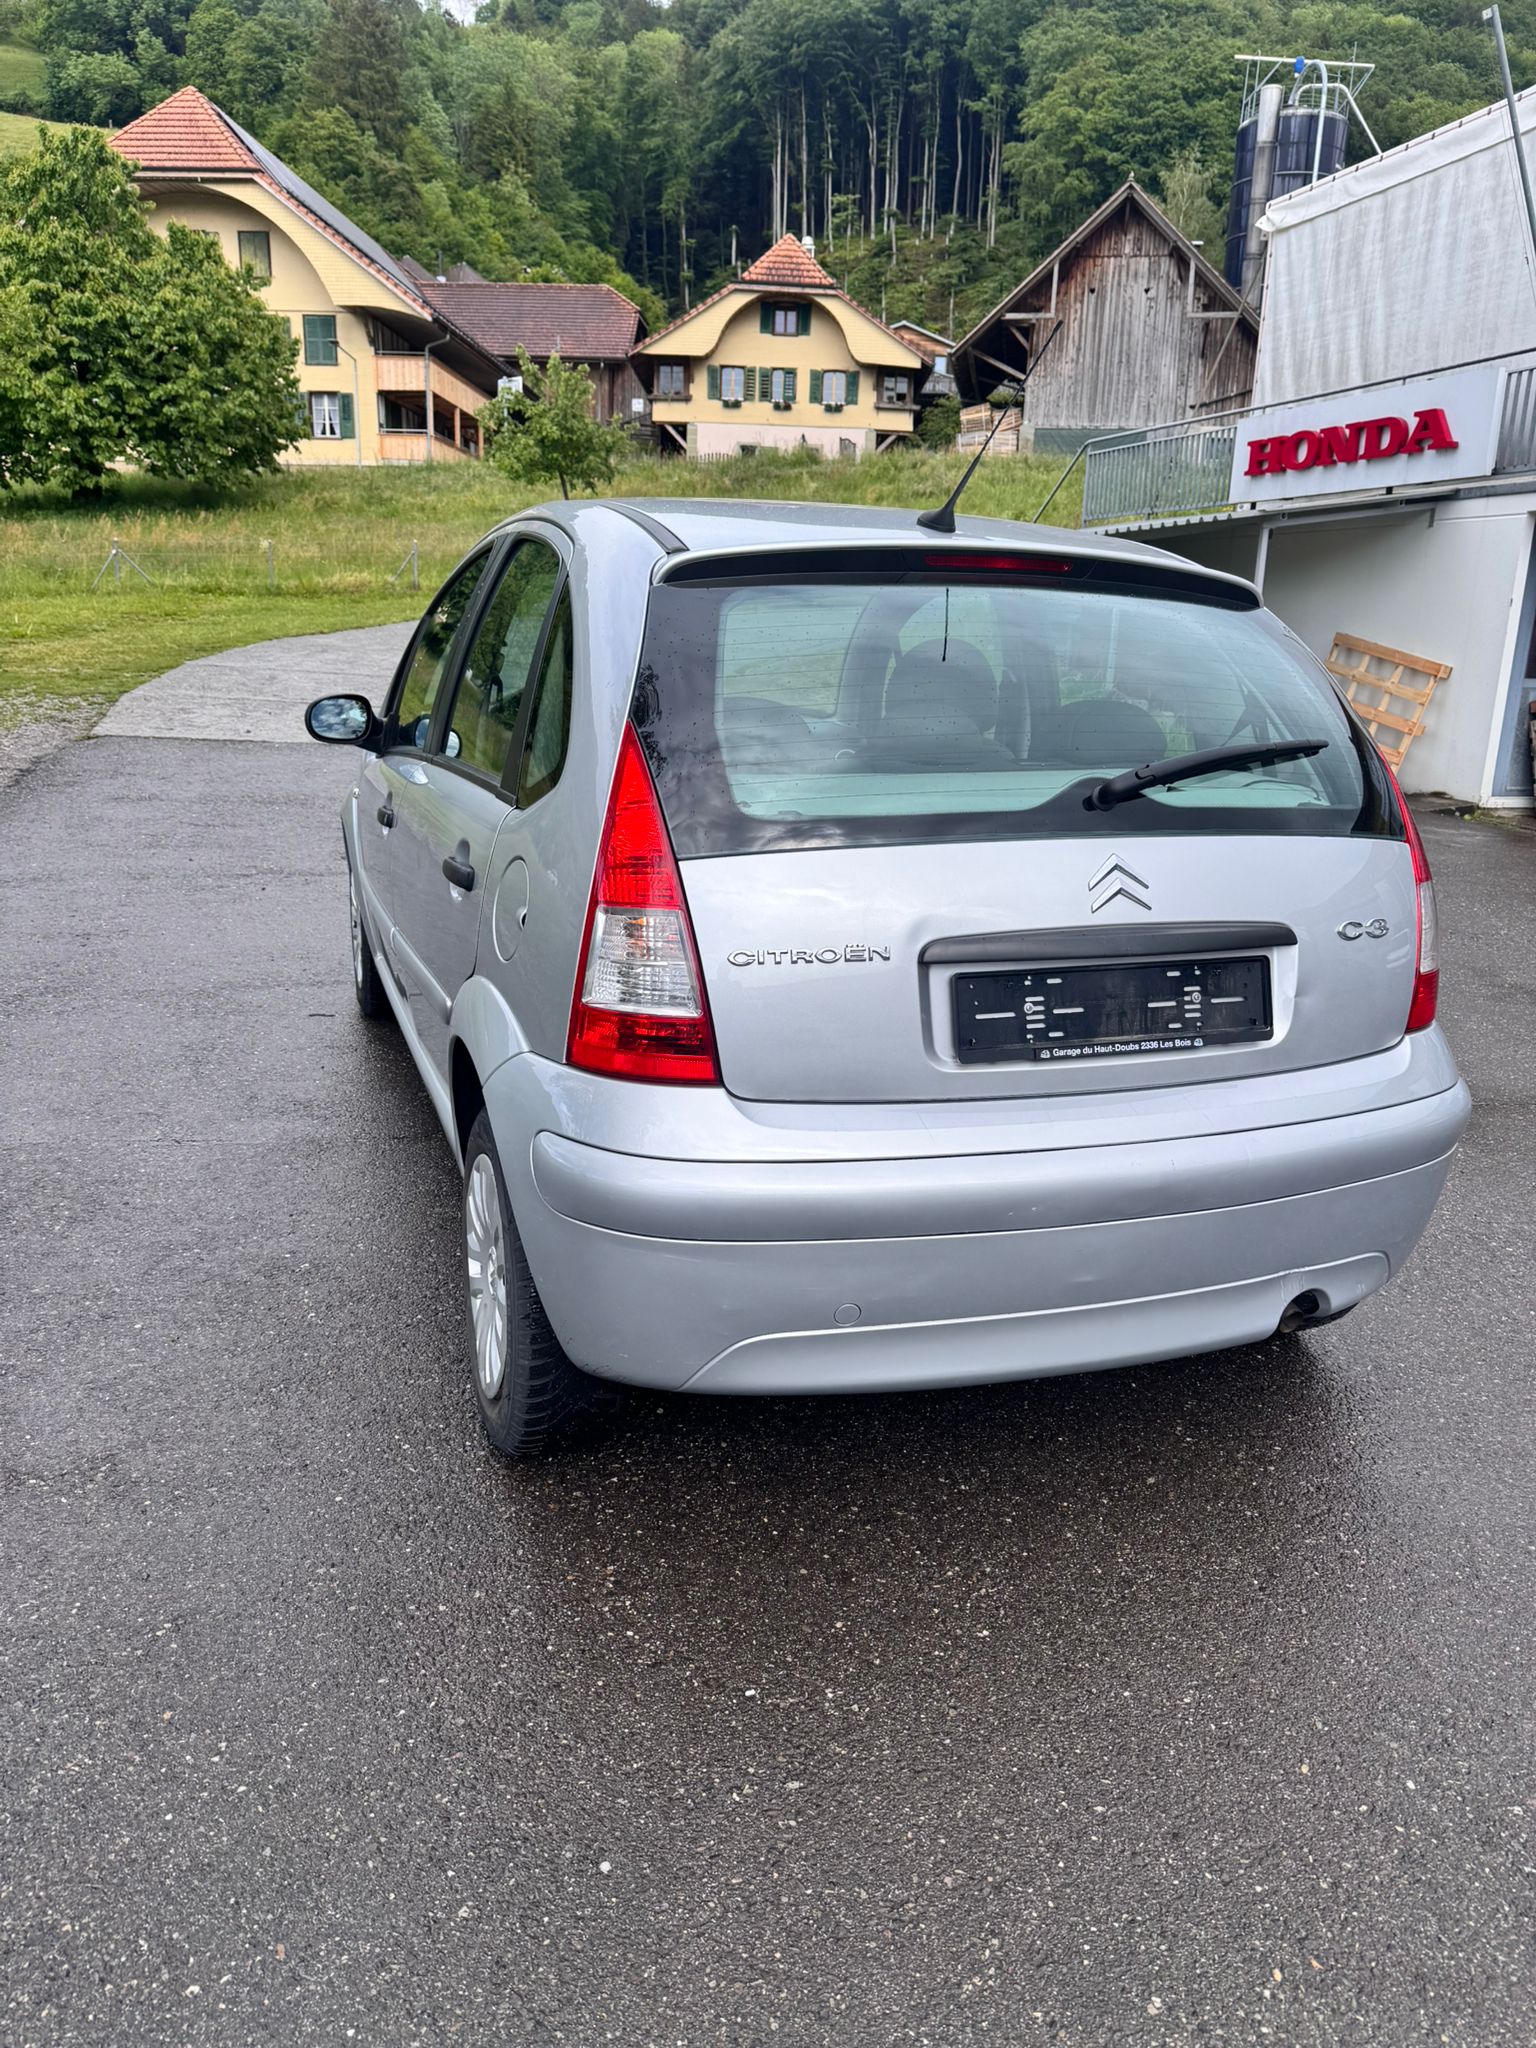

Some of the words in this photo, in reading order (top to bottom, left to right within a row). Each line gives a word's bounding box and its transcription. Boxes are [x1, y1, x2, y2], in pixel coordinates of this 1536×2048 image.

[1244, 408, 1459, 476] HONDA
[1336, 918, 1389, 941] C3
[727, 944, 891, 967] CITROËN
[1052, 1048, 1081, 1057] Garage
[1082, 1046, 1093, 1054] du
[1094, 1042, 1140, 1054] Haut-Doubs
[1140, 1041, 1159, 1050] 2336
[1160, 1040, 1174, 1048] Les
[1174, 1038, 1192, 1047] Bois
